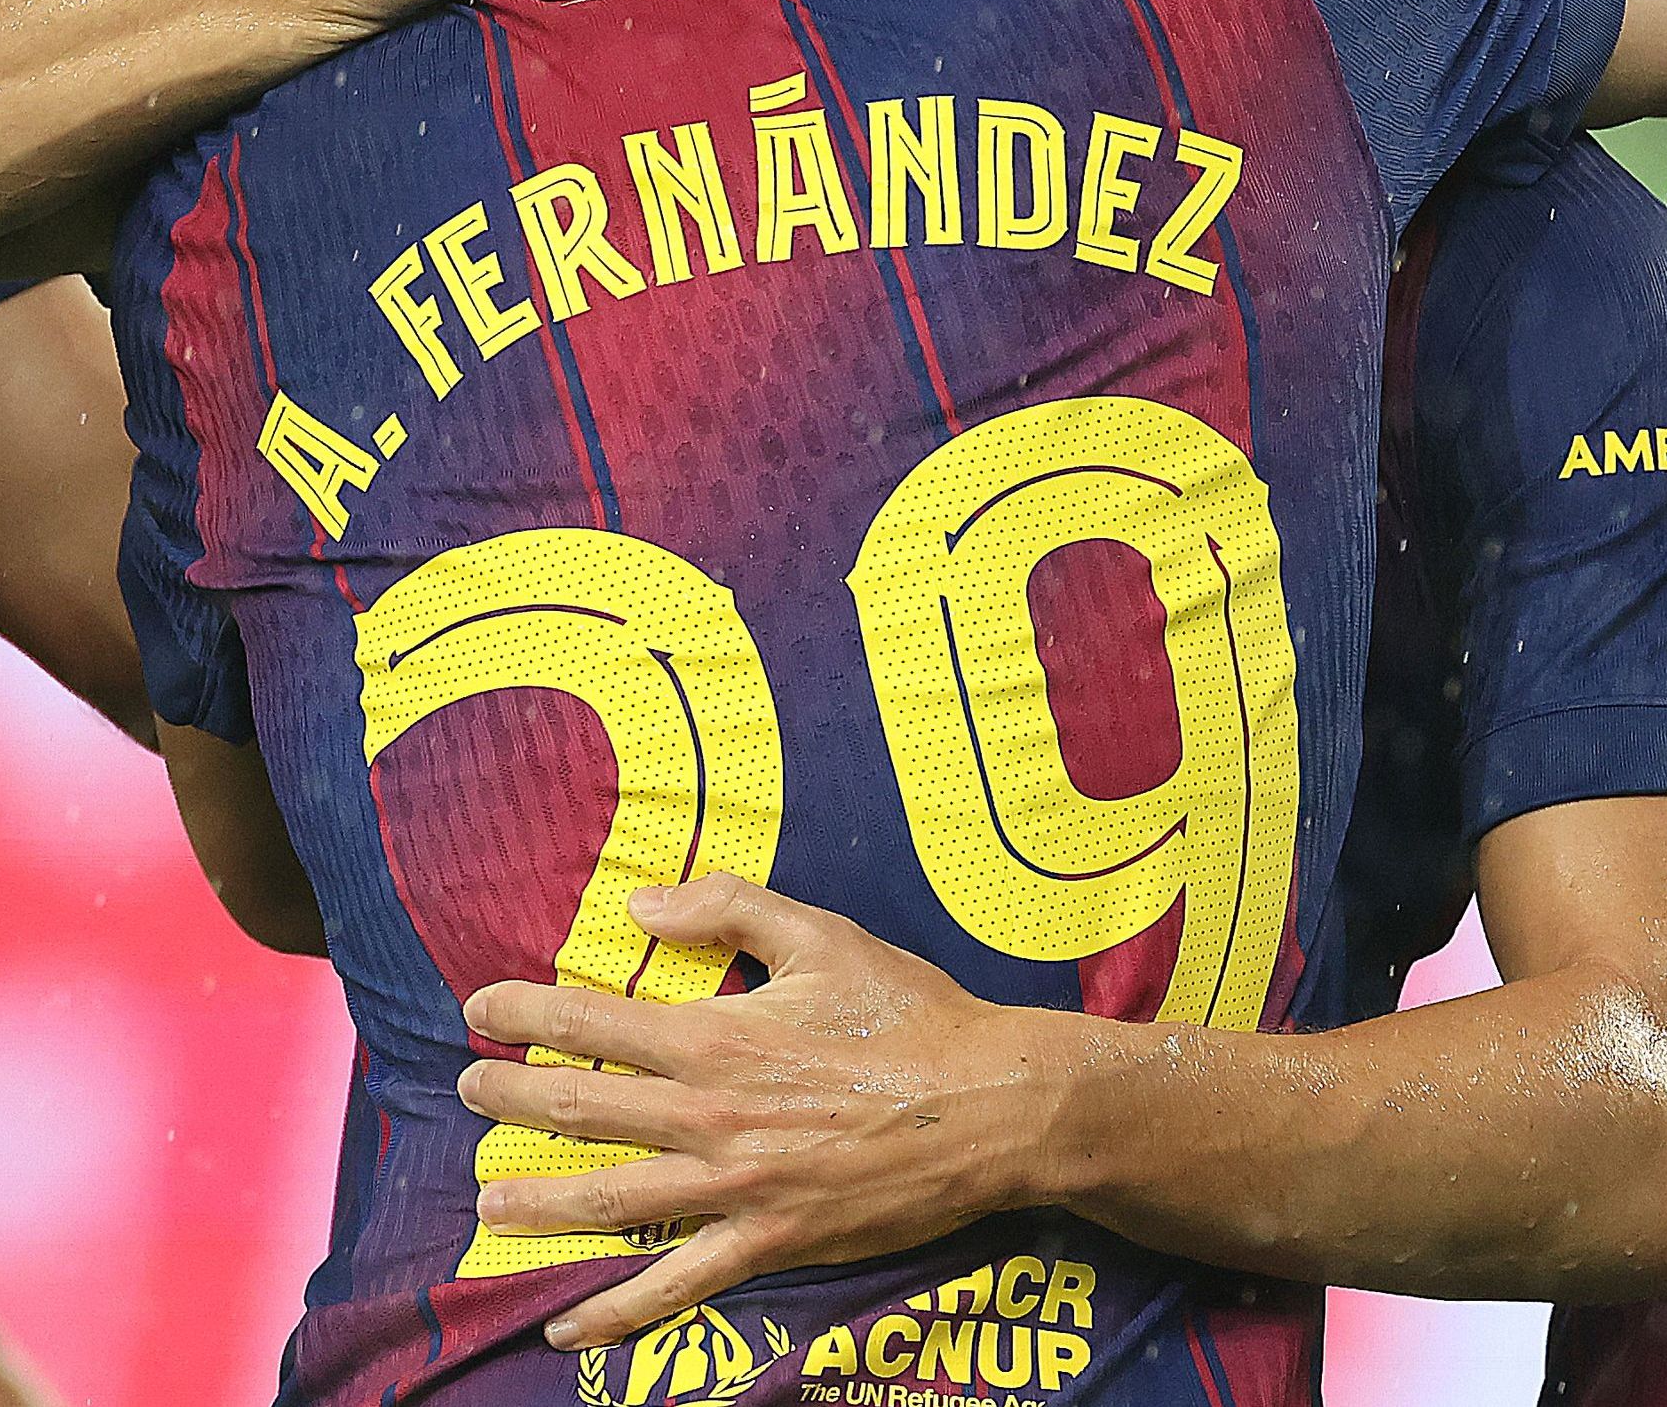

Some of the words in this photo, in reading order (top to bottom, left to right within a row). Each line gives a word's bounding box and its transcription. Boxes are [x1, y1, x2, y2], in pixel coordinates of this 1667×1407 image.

[256, 390, 407, 541] A.
[368, 72, 1245, 401] FERNÁNDEZ
[354, 395, 1300, 1279] 29
[800, 1383, 841, 1402] The
[845, 1381, 885, 1406] UN
